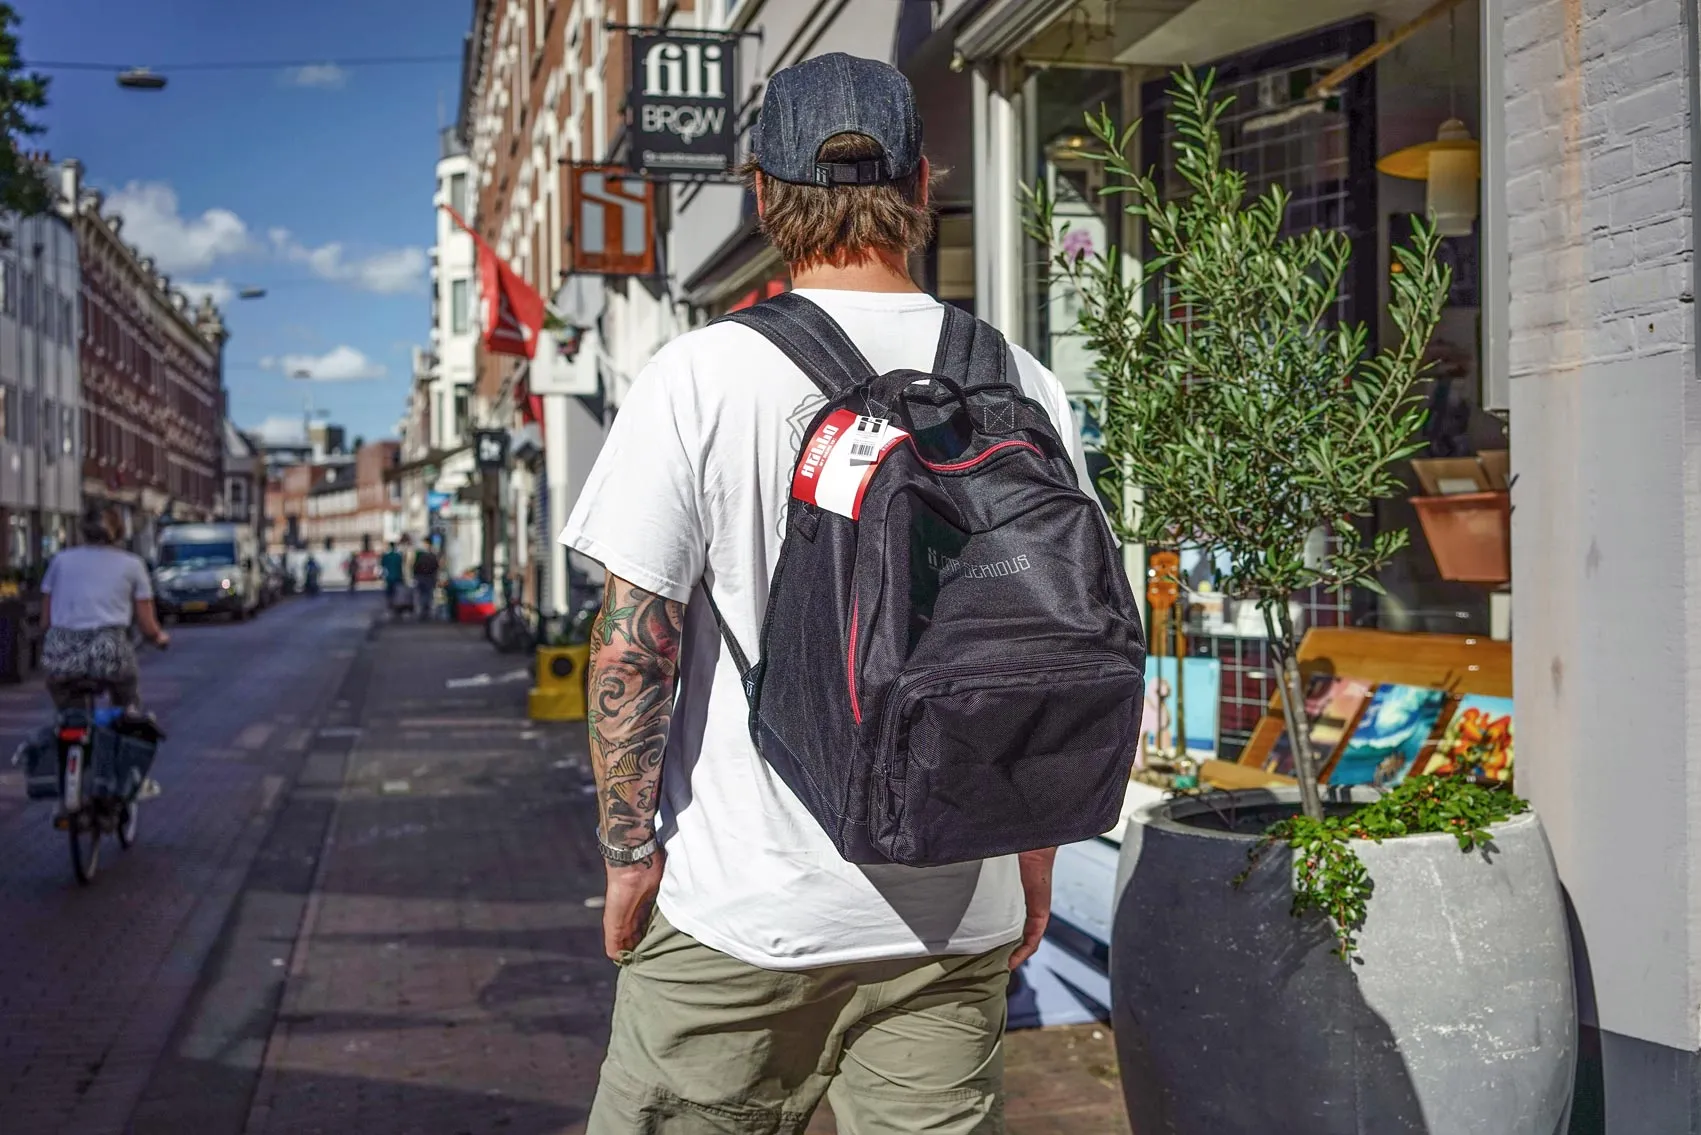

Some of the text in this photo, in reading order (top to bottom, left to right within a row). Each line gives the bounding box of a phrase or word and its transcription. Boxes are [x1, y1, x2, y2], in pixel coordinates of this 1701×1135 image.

[643, 43, 726, 98] fili
[642, 104, 726, 140] BROW
[799, 423, 839, 478] HELLO
